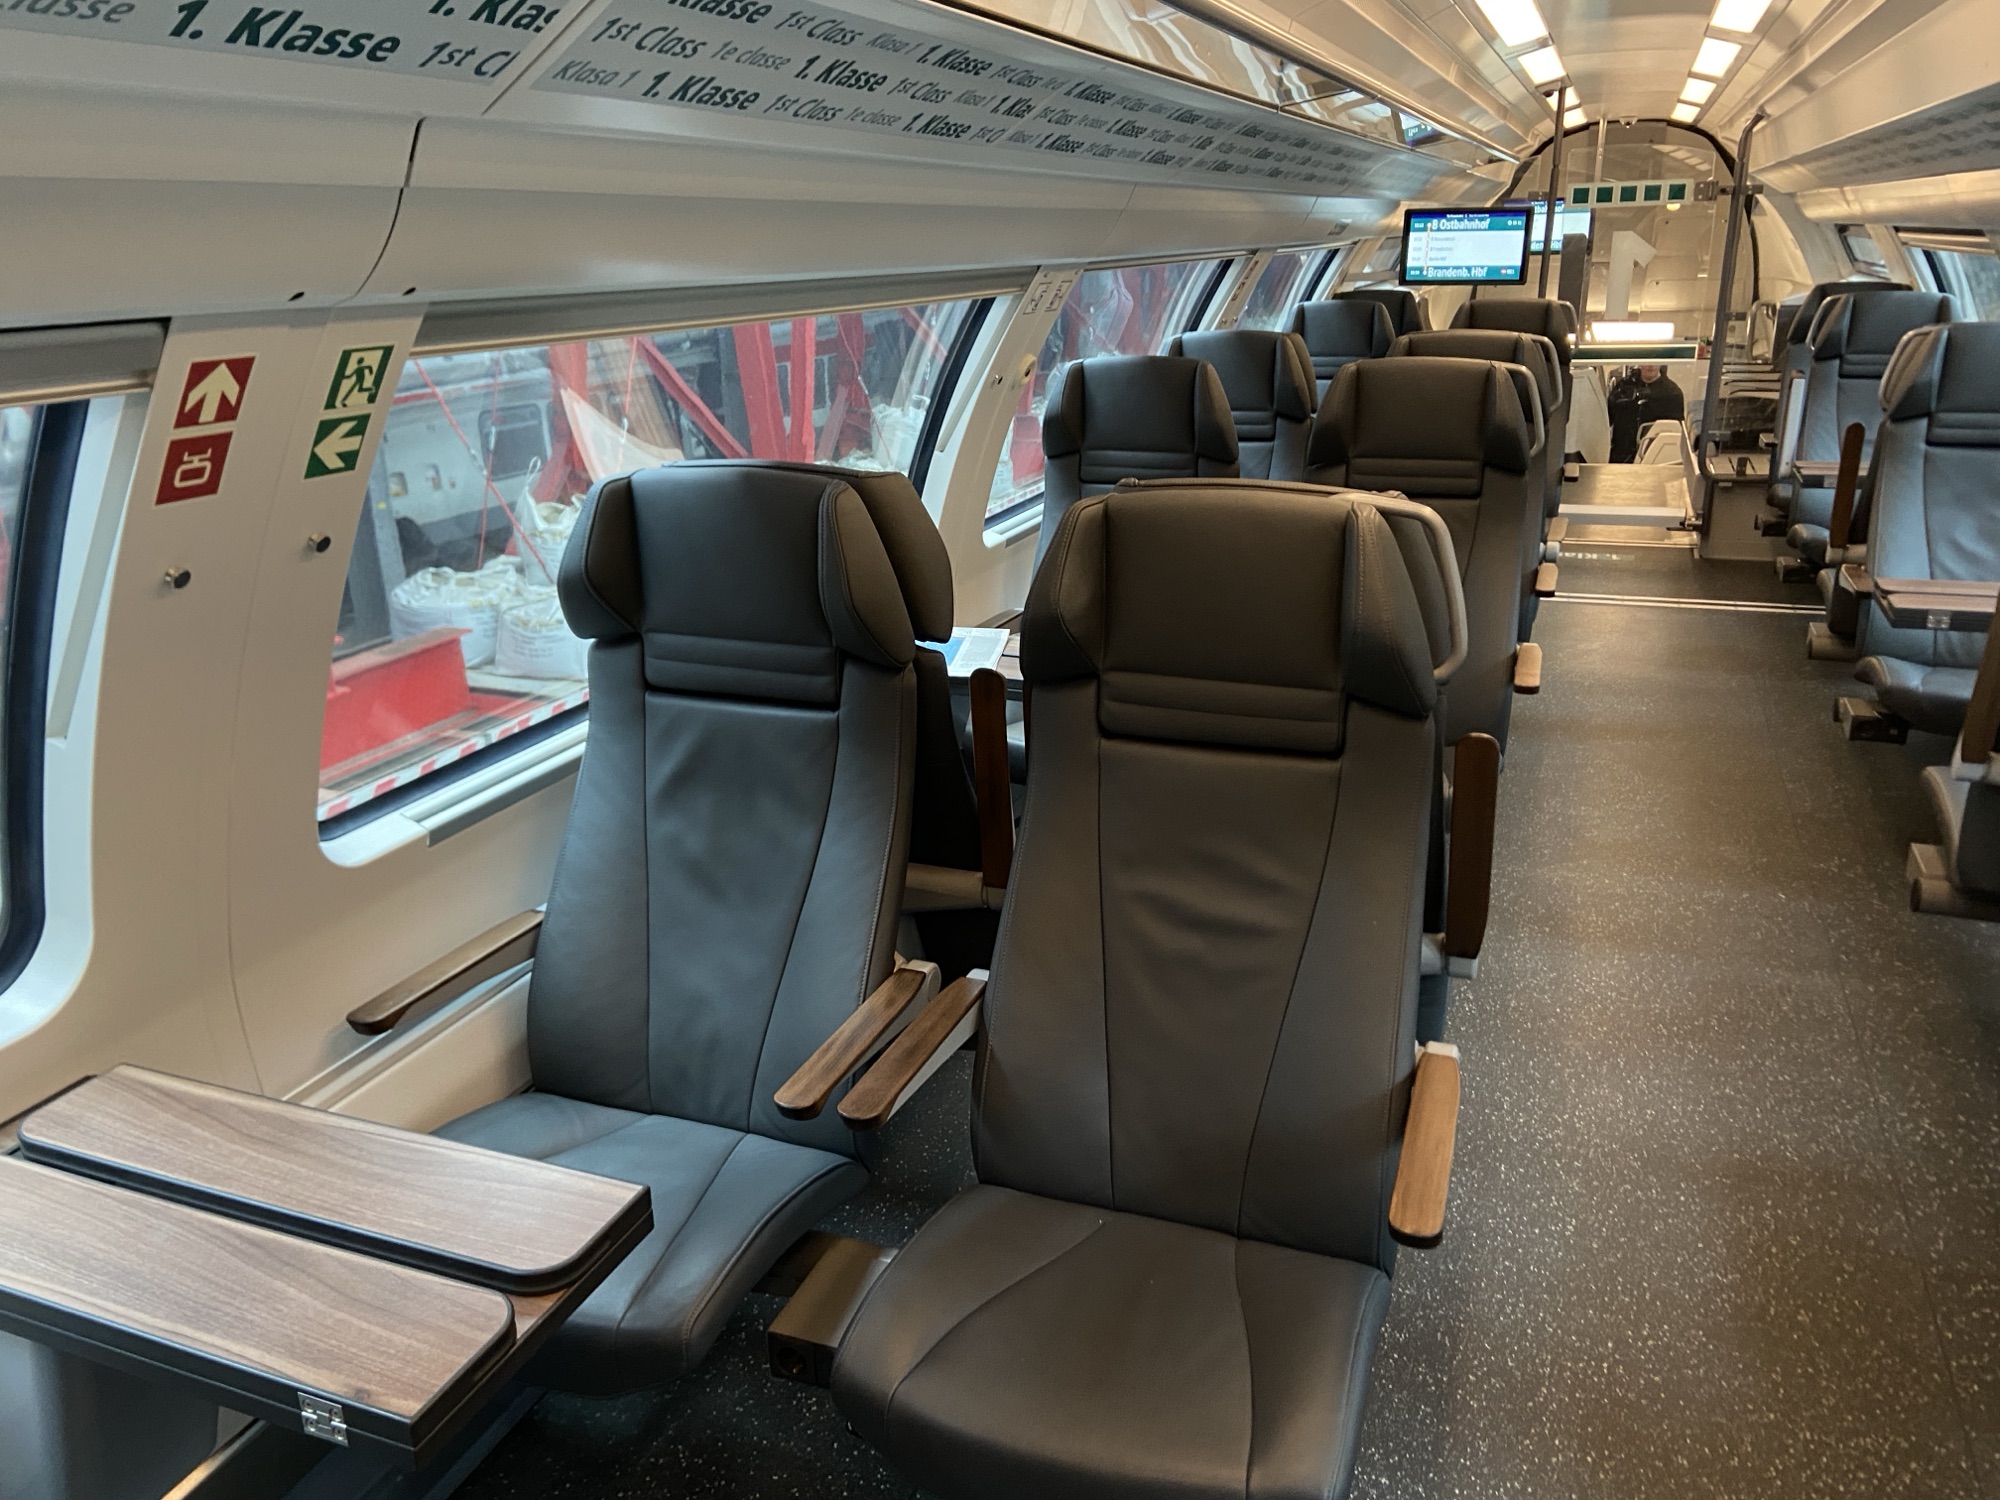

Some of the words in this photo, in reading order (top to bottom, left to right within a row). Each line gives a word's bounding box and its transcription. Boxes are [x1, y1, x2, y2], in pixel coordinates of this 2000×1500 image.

[0, 0, 135, 23] asse
[168, 0, 205, 39] 1.
[225, 6, 400, 62] Klasse
[418, 41, 477, 67] 1st
[591, 17, 641, 42] 1st
[634, 26, 707, 58] Class
[710, 40, 738, 60] 1e
[735, 46, 791, 71] classe
[794, 55, 821, 79] 1.
[814, 58, 888, 92] Klasse
[887, 77, 920, 95] 1st
[910, 82, 953, 104] Class
[667, 0, 772, 23] asse
[774, 10, 816, 29] 1st
[806, 18, 863, 46] Class
[917, 45, 942, 63] 1.
[933, 48, 993, 76] Klasse
[990, 65, 1018, 79] 1st
[1007, 69, 1044, 88] Class
[552, 60, 618, 86] Klasa
[619, 70, 641, 88] 1
[641, 71, 670, 98] 1.
[668, 75, 760, 110] Klasse
[763, 94, 800, 114] 1st
[792, 98, 844, 122] Class
[902, 112, 924, 132] 1.
[916, 114, 972, 139] Klasse
[1439, 218, 1490, 230] Ostbahnhof
[1427, 266, 1470, 278] Brandenb.
[1471, 266, 1488, 277] Hbf
